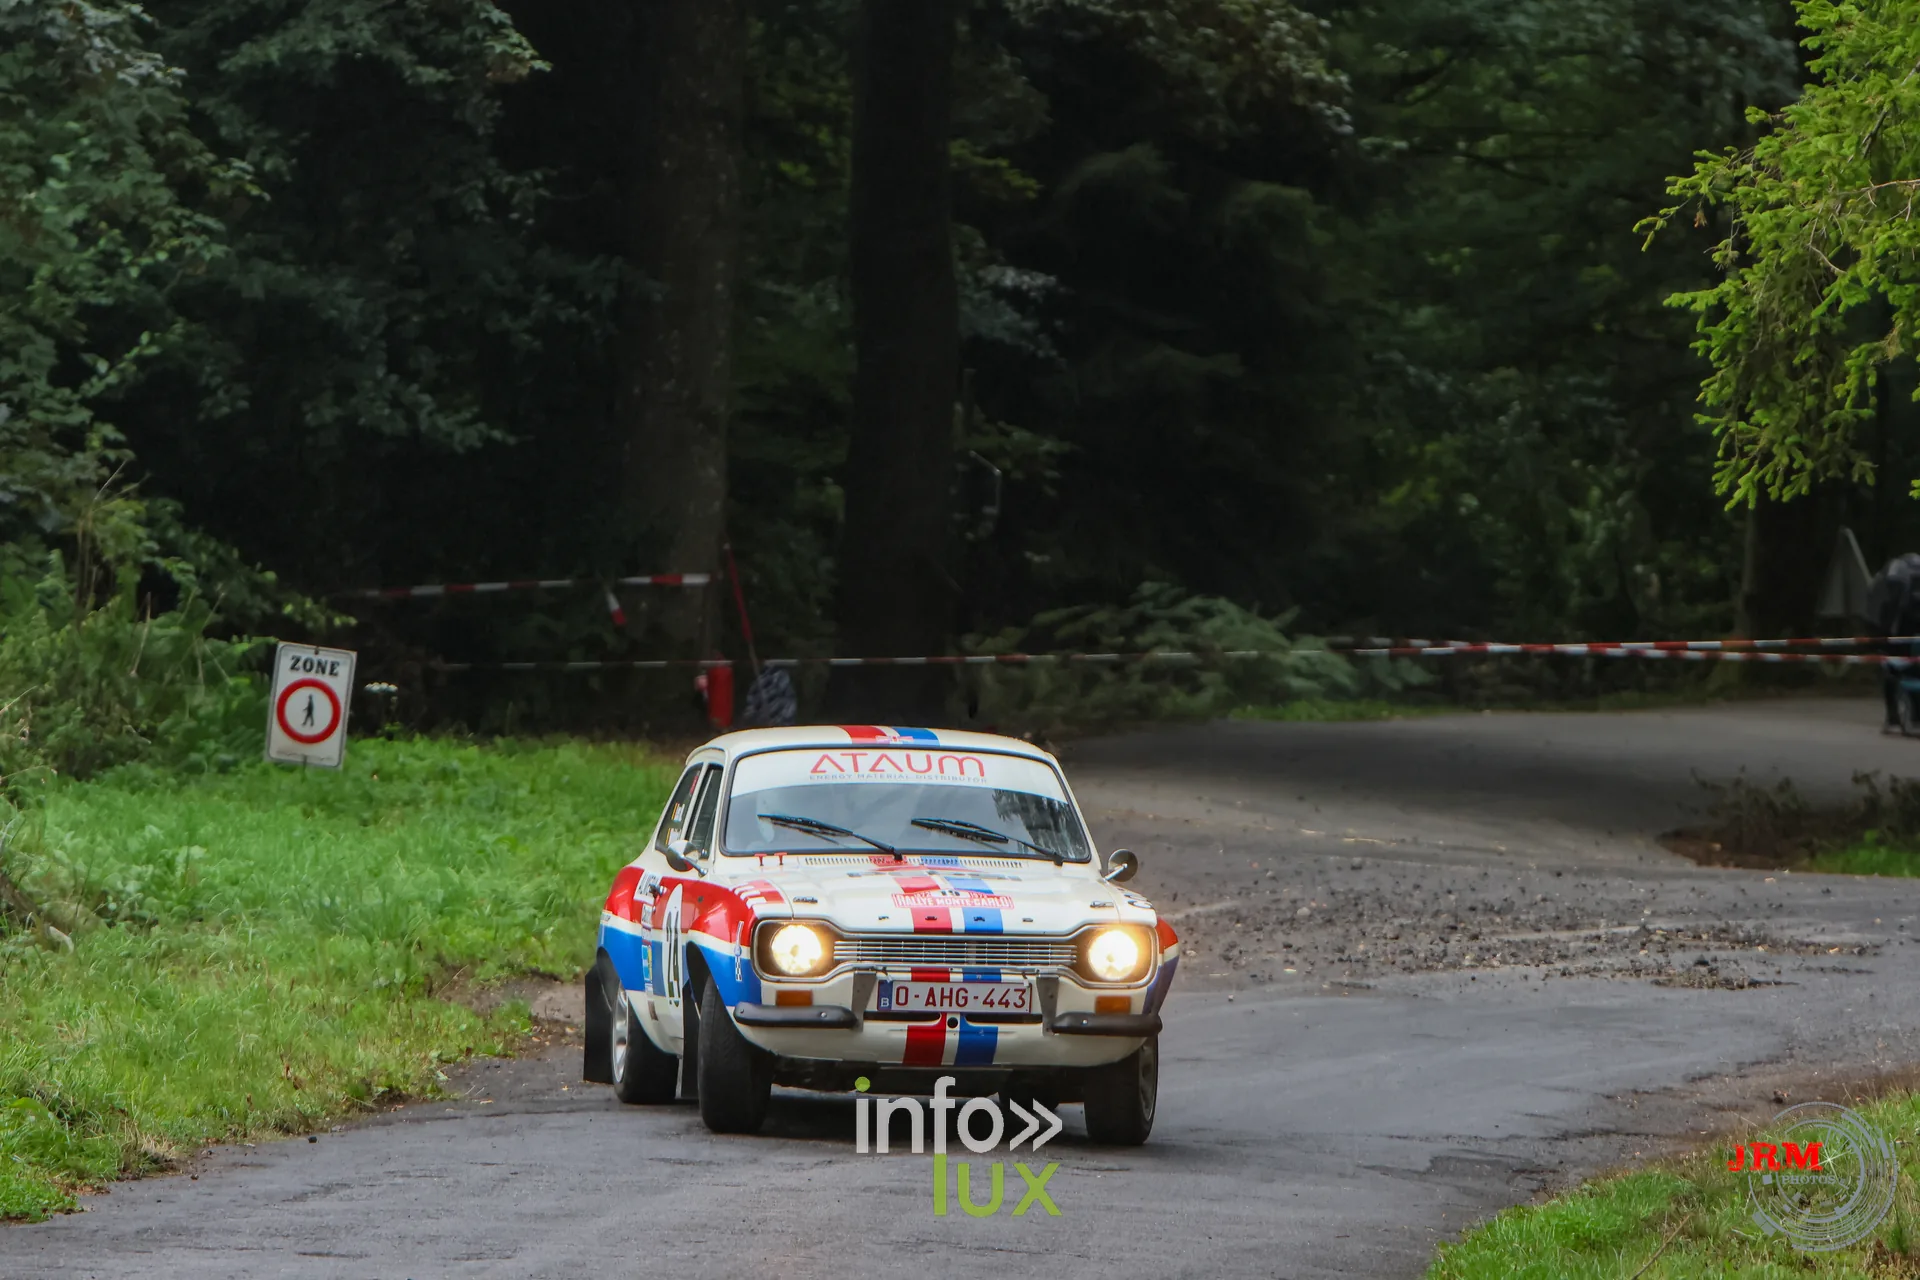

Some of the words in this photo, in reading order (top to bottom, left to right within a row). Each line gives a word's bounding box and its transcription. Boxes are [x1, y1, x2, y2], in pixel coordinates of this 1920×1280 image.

[289, 654, 340, 676] ZONE
[810, 752, 985, 777] ATAUM
[857, 773, 909, 781] MATERIAL
[915, 774, 988, 783] DISTRIBUTOR
[898, 894, 933, 907] RALLYE
[880, 997, 889, 1007] B
